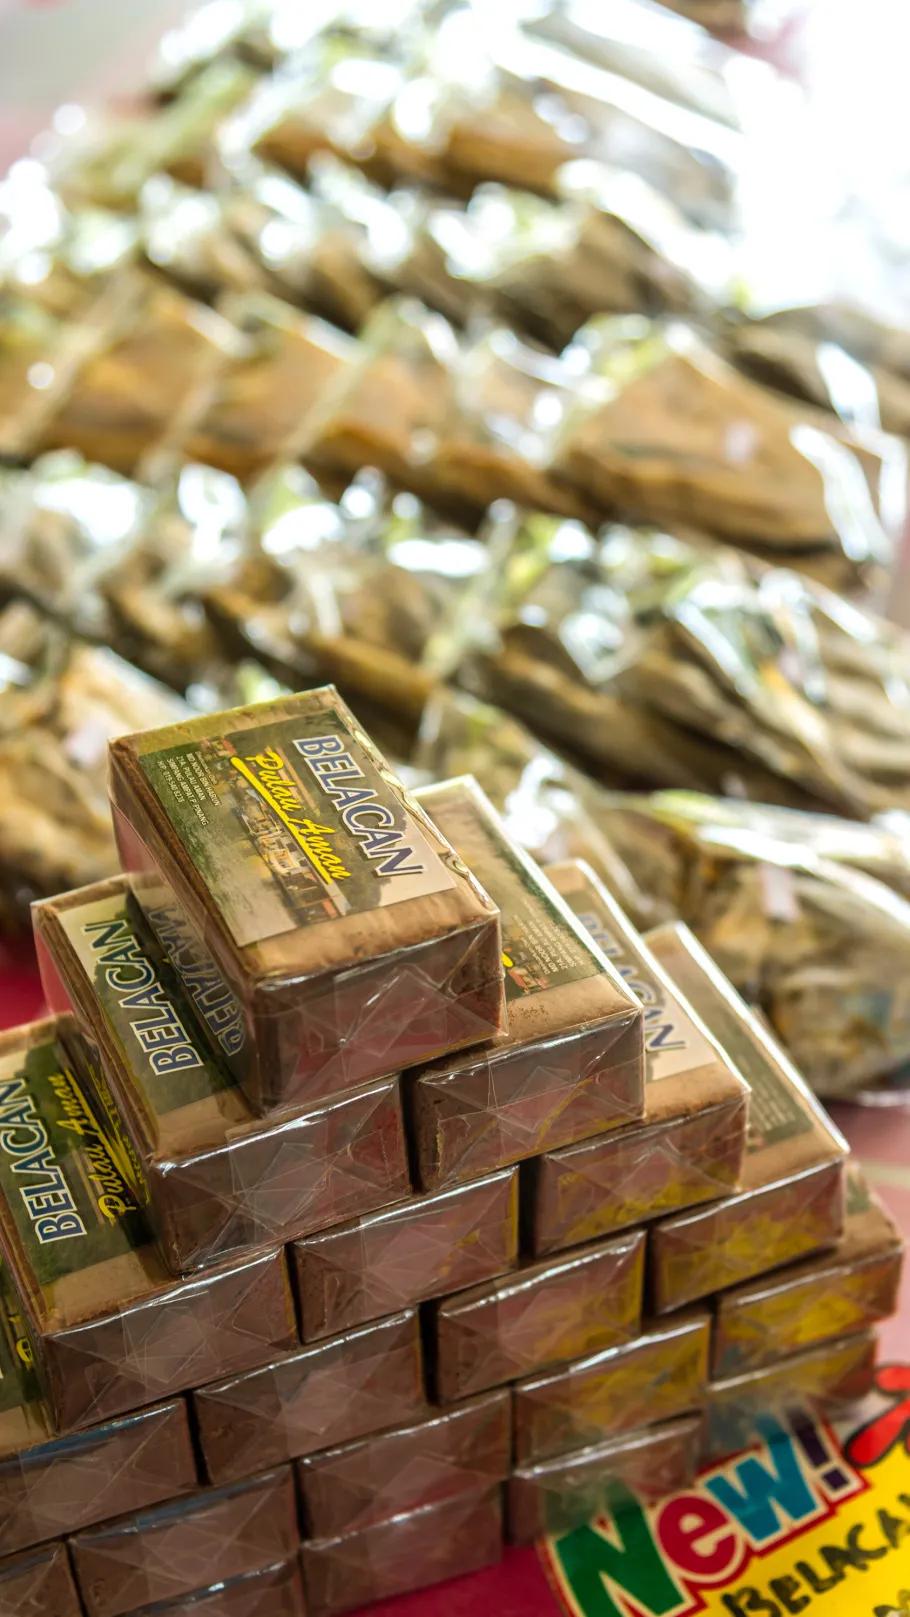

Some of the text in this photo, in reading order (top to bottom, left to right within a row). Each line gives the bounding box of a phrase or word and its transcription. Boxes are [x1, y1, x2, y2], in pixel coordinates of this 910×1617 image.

[193, 803, 209, 826] PINANG
[244, 745, 351, 880] Pulau Aman
[292, 734, 424, 877] BELACAN
[83, 918, 204, 1076] BELACAN
[0, 1078, 88, 1245] BELACAN
[48, 1073, 99, 1136] Aman
[85, 1143, 137, 1227] Pulau
[720, 1493, 910, 1617] BELACA
